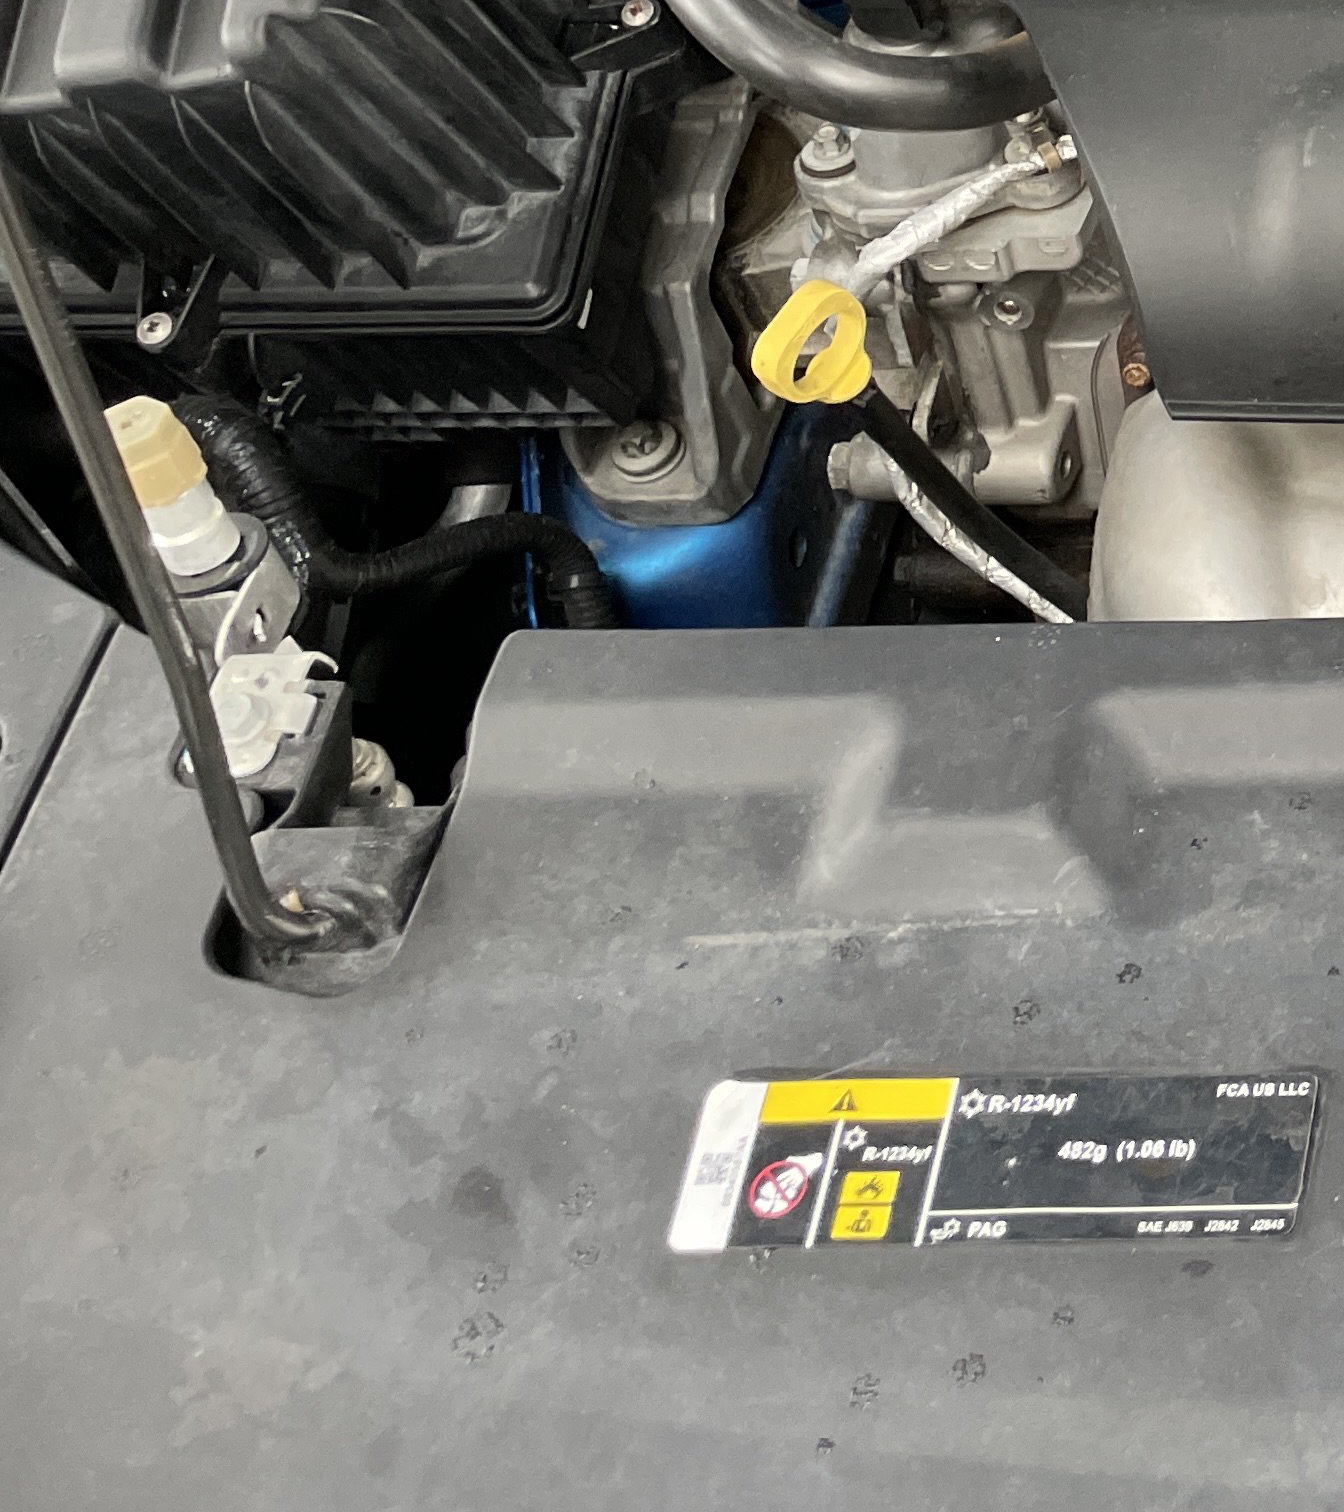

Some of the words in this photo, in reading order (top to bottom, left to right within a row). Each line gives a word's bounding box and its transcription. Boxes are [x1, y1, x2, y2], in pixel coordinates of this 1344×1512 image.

[1216, 1083, 1249, 1098] FCA
[1278, 1081, 1311, 1096] LLC
[987, 1092, 1079, 1117] R-1234yf
[1057, 1140, 1107, 1165] 482g
[1116, 1140, 1163, 1162] (1.06
[1167, 1138, 1198, 1161] lb)
[967, 1220, 1007, 1239] PAG
